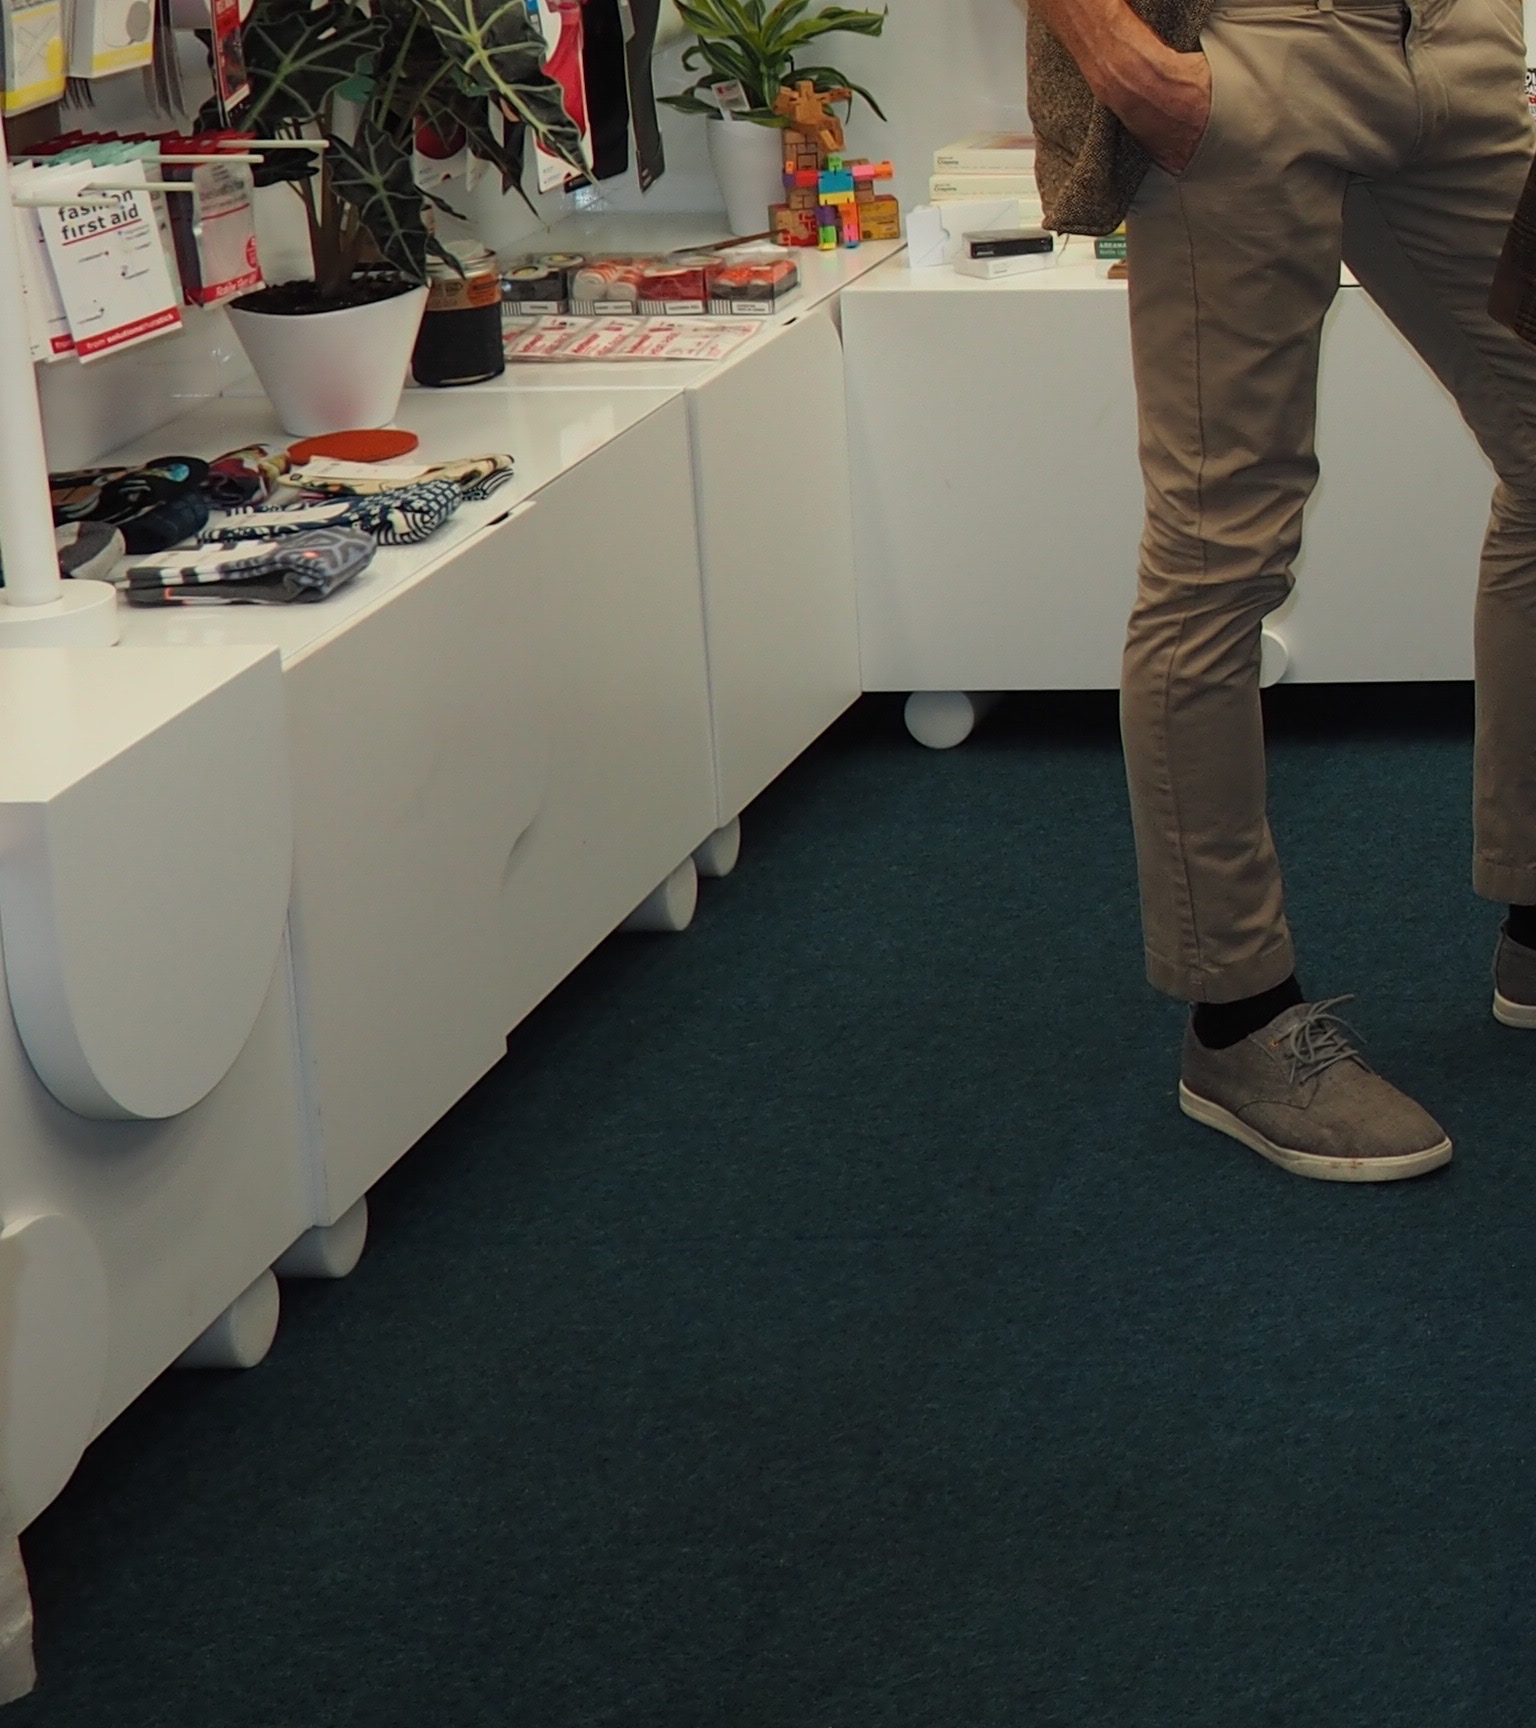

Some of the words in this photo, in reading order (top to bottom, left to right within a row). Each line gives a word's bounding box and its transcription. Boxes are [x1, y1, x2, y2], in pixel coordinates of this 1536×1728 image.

[58, 190, 133, 222] fason
[62, 216, 107, 241] first
[110, 203, 139, 226] aid
